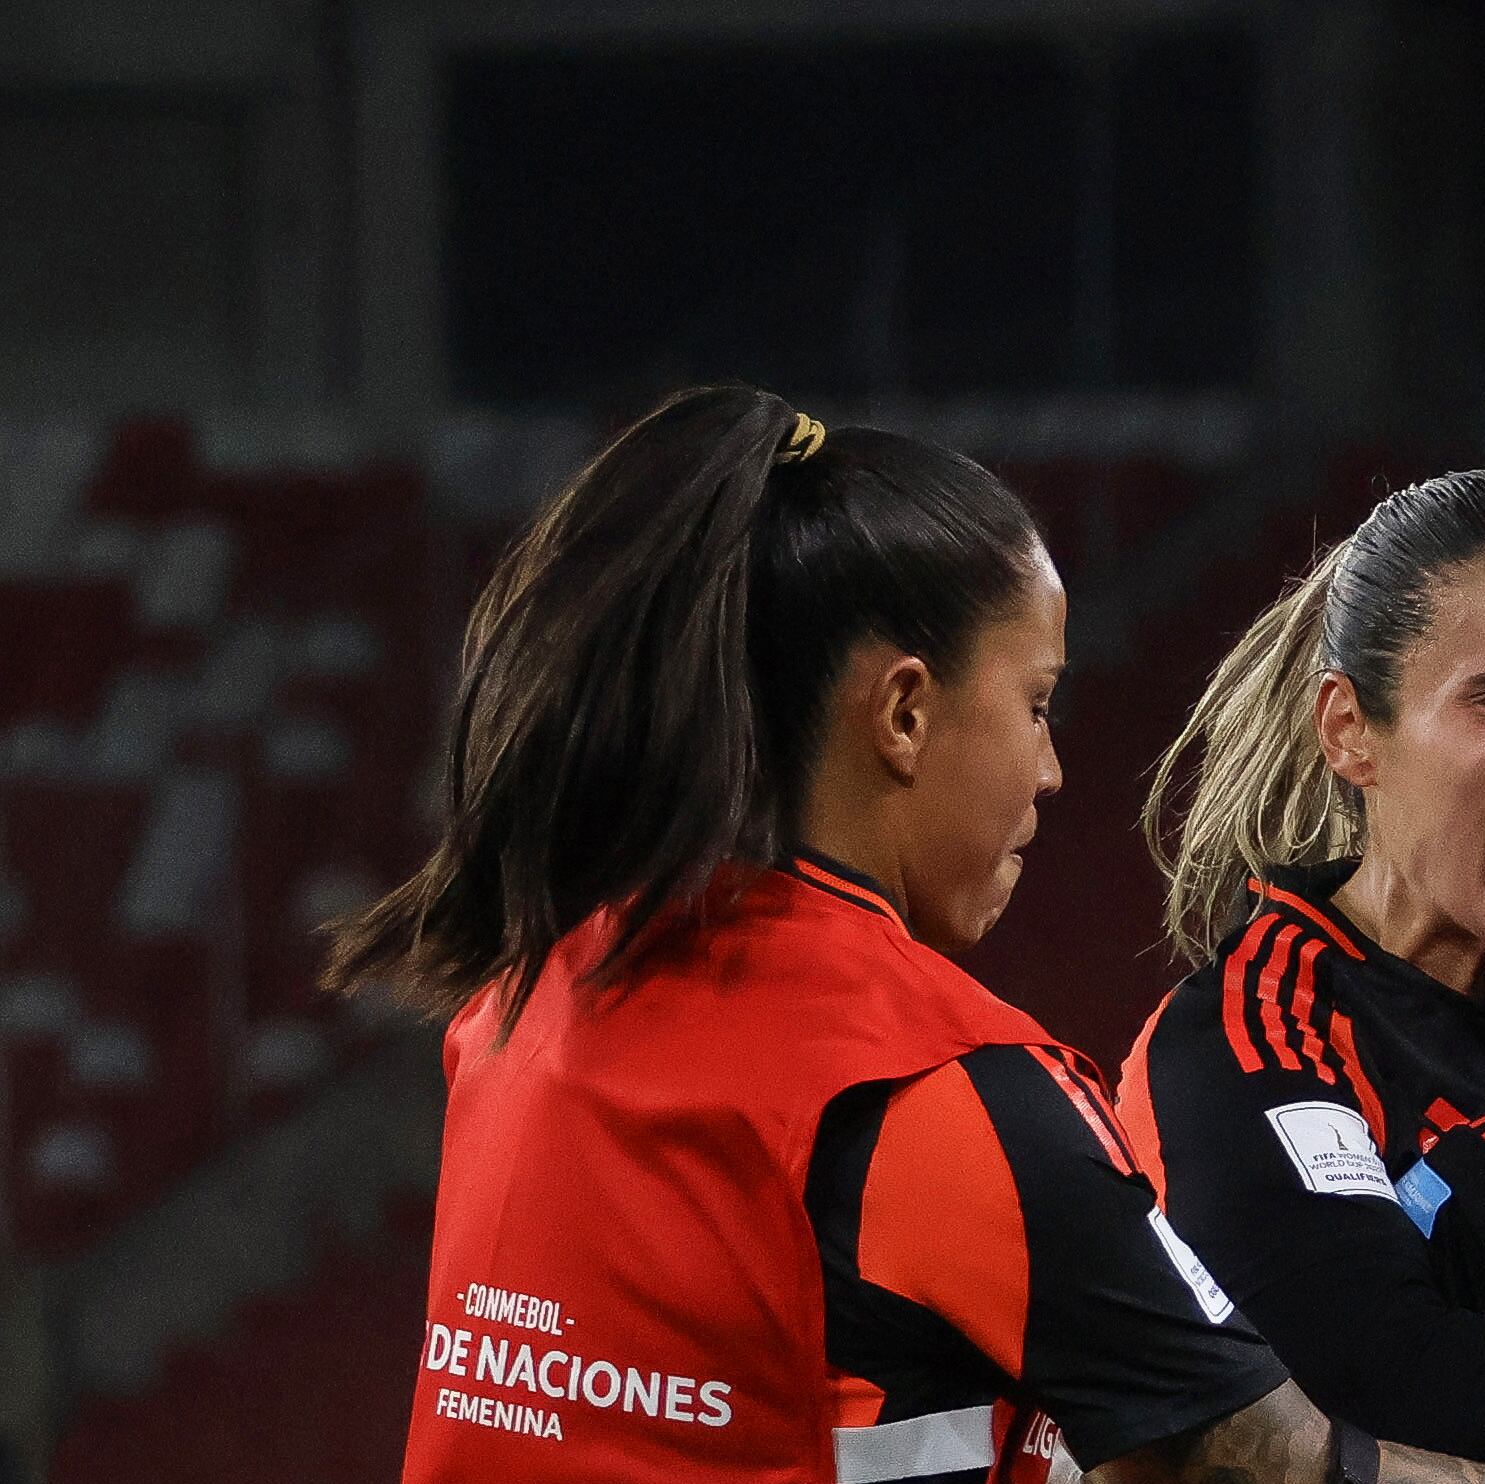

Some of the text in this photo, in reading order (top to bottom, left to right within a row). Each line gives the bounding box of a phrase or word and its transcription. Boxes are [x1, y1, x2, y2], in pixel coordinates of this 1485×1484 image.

[426, 1323, 472, 1377] DE
[475, 1335, 733, 1428] NACIONES
[436, 1387, 563, 1441] FEMENINA
[1022, 1411, 1056, 1459] LIG
